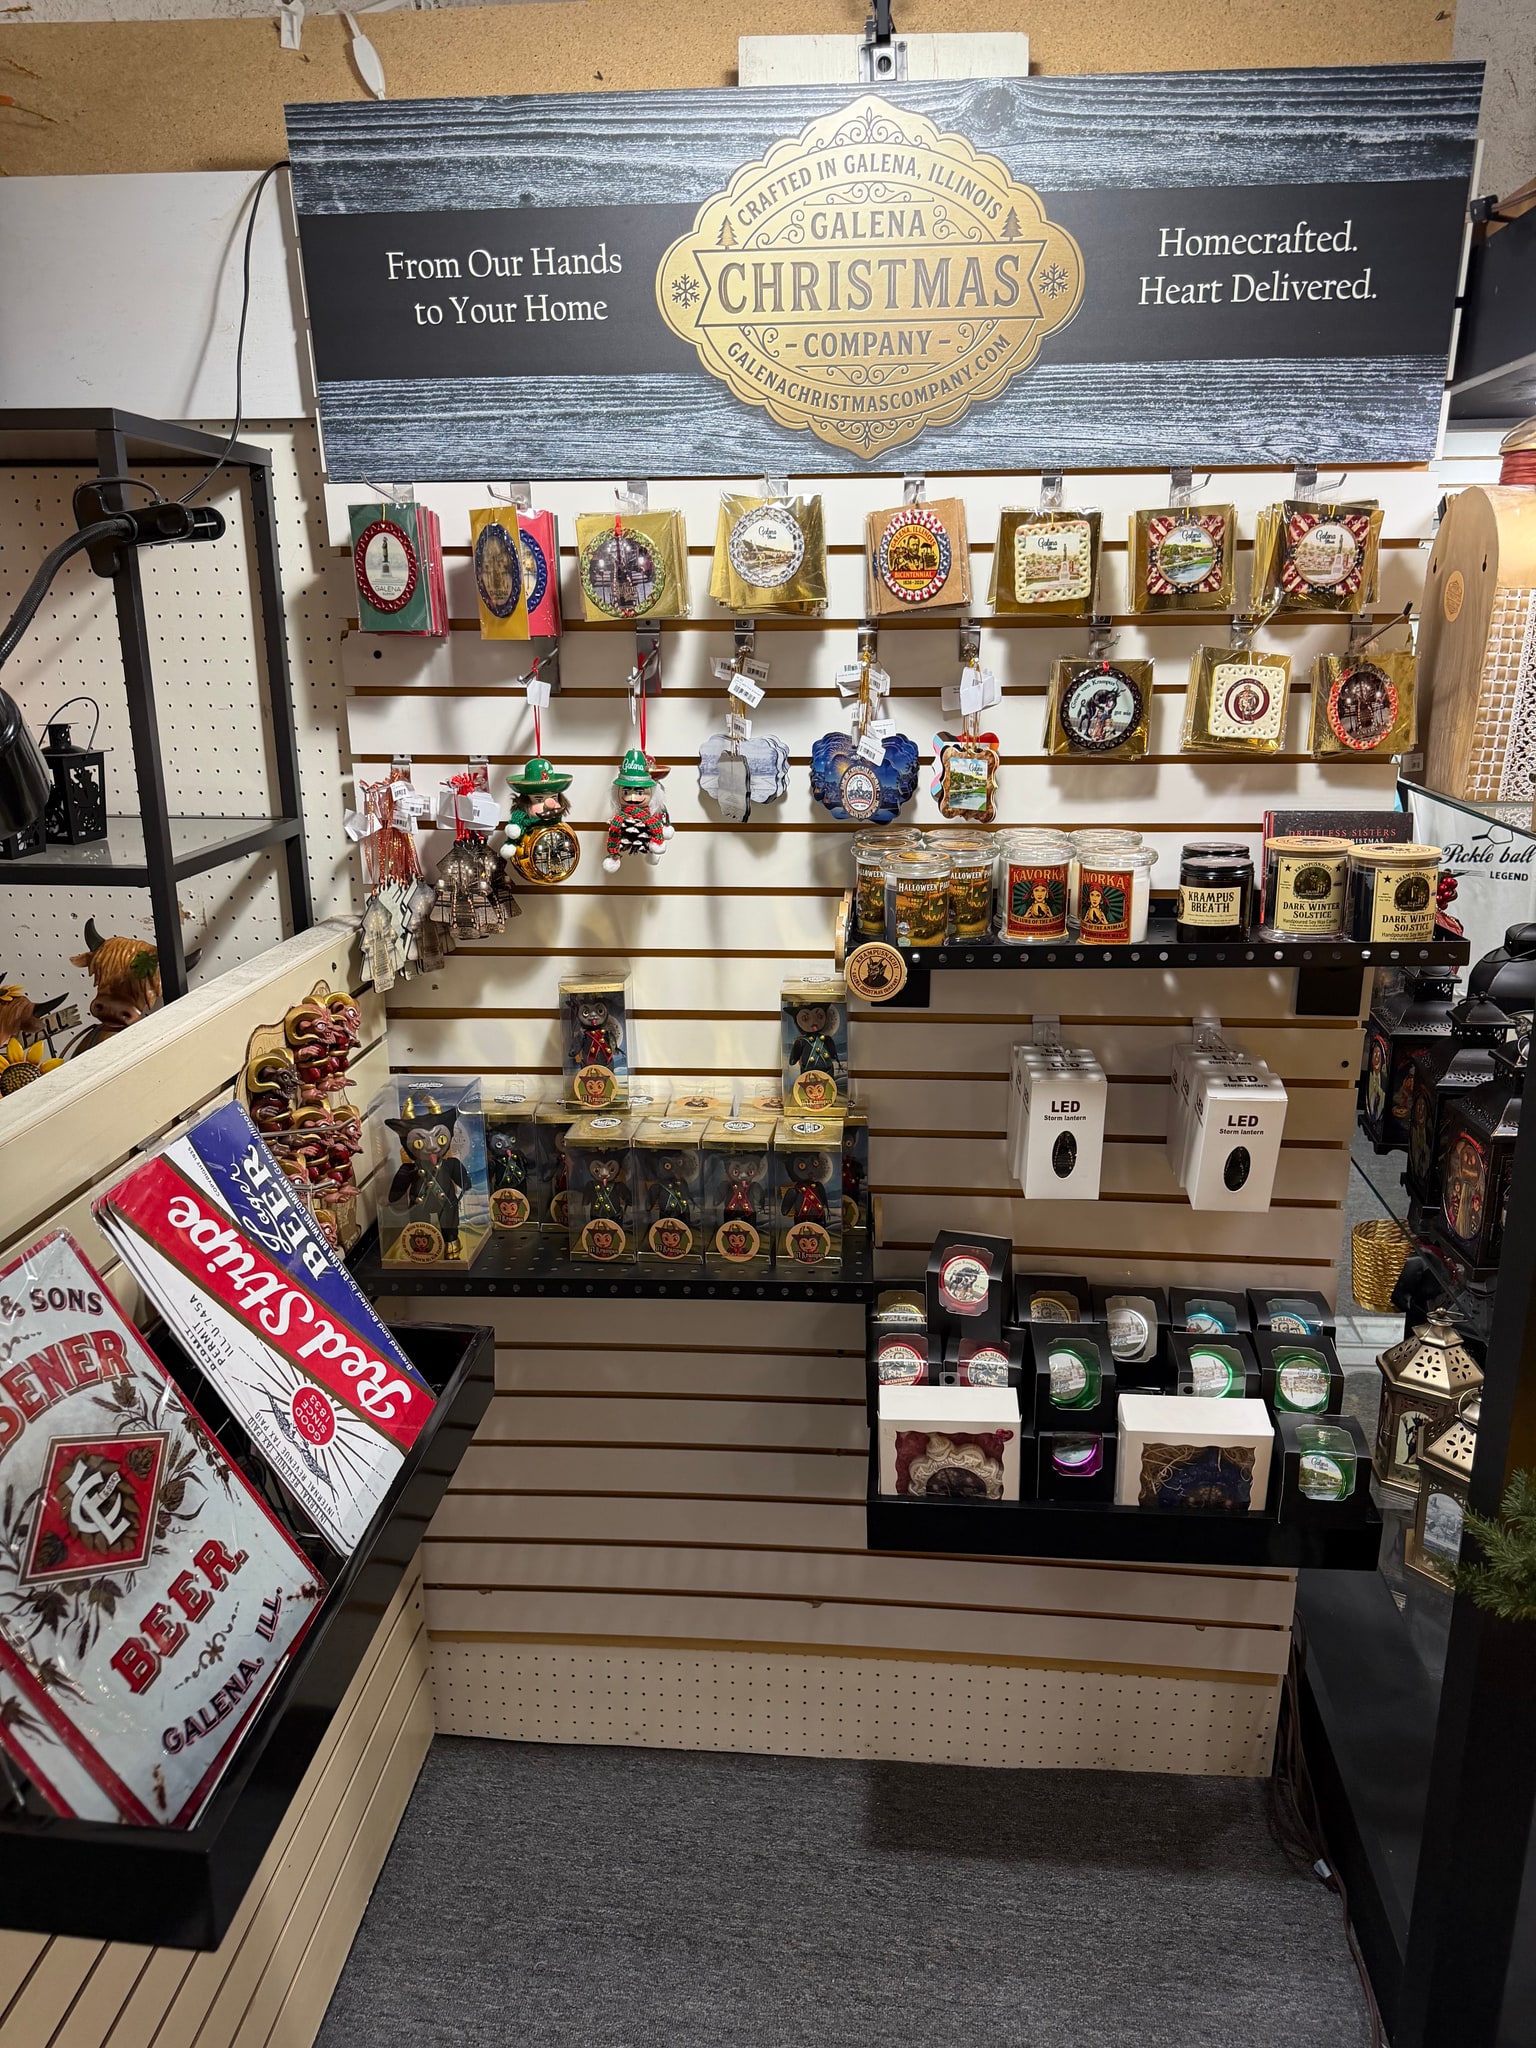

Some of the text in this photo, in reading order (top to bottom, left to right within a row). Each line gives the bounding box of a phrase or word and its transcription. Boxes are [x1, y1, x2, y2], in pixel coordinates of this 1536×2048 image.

[737, 152, 1004, 227] CRAFTED IN GALENA, ILLINOIS
[810, 209, 927, 241] GALENA
[1157, 219, 1358, 259] Homecrafted.
[385, 243, 623, 281] From Our Hands
[718, 254, 1021, 315] CHRISTMAS
[1138, 268, 1378, 306] Heart Delivered.
[414, 293, 609, 326] to Your Home
[803, 329, 932, 359] COMPANY
[727, 335, 1011, 414] GALENACHRISTMASCOMPANY.COM
[622, 758, 644, 773] Galena
[1288, 828, 1397, 837] DRIFTLESS SISTERS
[1439, 843, 1536, 864] Pickle ball
[898, 882, 938, 892] HALLOWEEN
[950, 871, 982, 879] ALLOWEEN
[1013, 869, 1065, 883] KAVORKA
[1489, 871, 1529, 881] LEGEND
[1188, 891, 1235, 902] KRAMPUS
[1191, 903, 1230, 913] BREATH
[1283, 901, 1340, 911] DARK WINTER
[1293, 911, 1332, 919] SOLSTICE
[1382, 915, 1407, 923] DARK
[1394, 922, 1430, 932] SOLSTICE
[856, 949, 899, 969] KRAMPUSNACHT
[1051, 1100, 1081, 1113] LED
[1227, 1114, 1259, 1127] LED
[196, 1161, 220, 1197] COPYRIGHT
[230, 1163, 292, 1255] Lager
[243, 1144, 331, 1282] BEER
[237, 1106, 413, 1371] Brewed and Bottled by GALENA BREWING COMPANY Galena, Illinois
[29, 1287, 103, 1316] SONS
[167, 1196, 413, 1419] Red Stripe
[189, 1293, 234, 1357] ILL-U-745A
[192, 1322, 226, 1367] PERMIT
[295, 1406, 321, 1442] GOOD
[301, 1398, 327, 1434] SINCE
[309, 1394, 330, 1423] 1833
[254, 1411, 335, 1518] INTERNAL REVENUE TAX PAID
[162, 1587, 283, 1755] GALENA, ILL.
